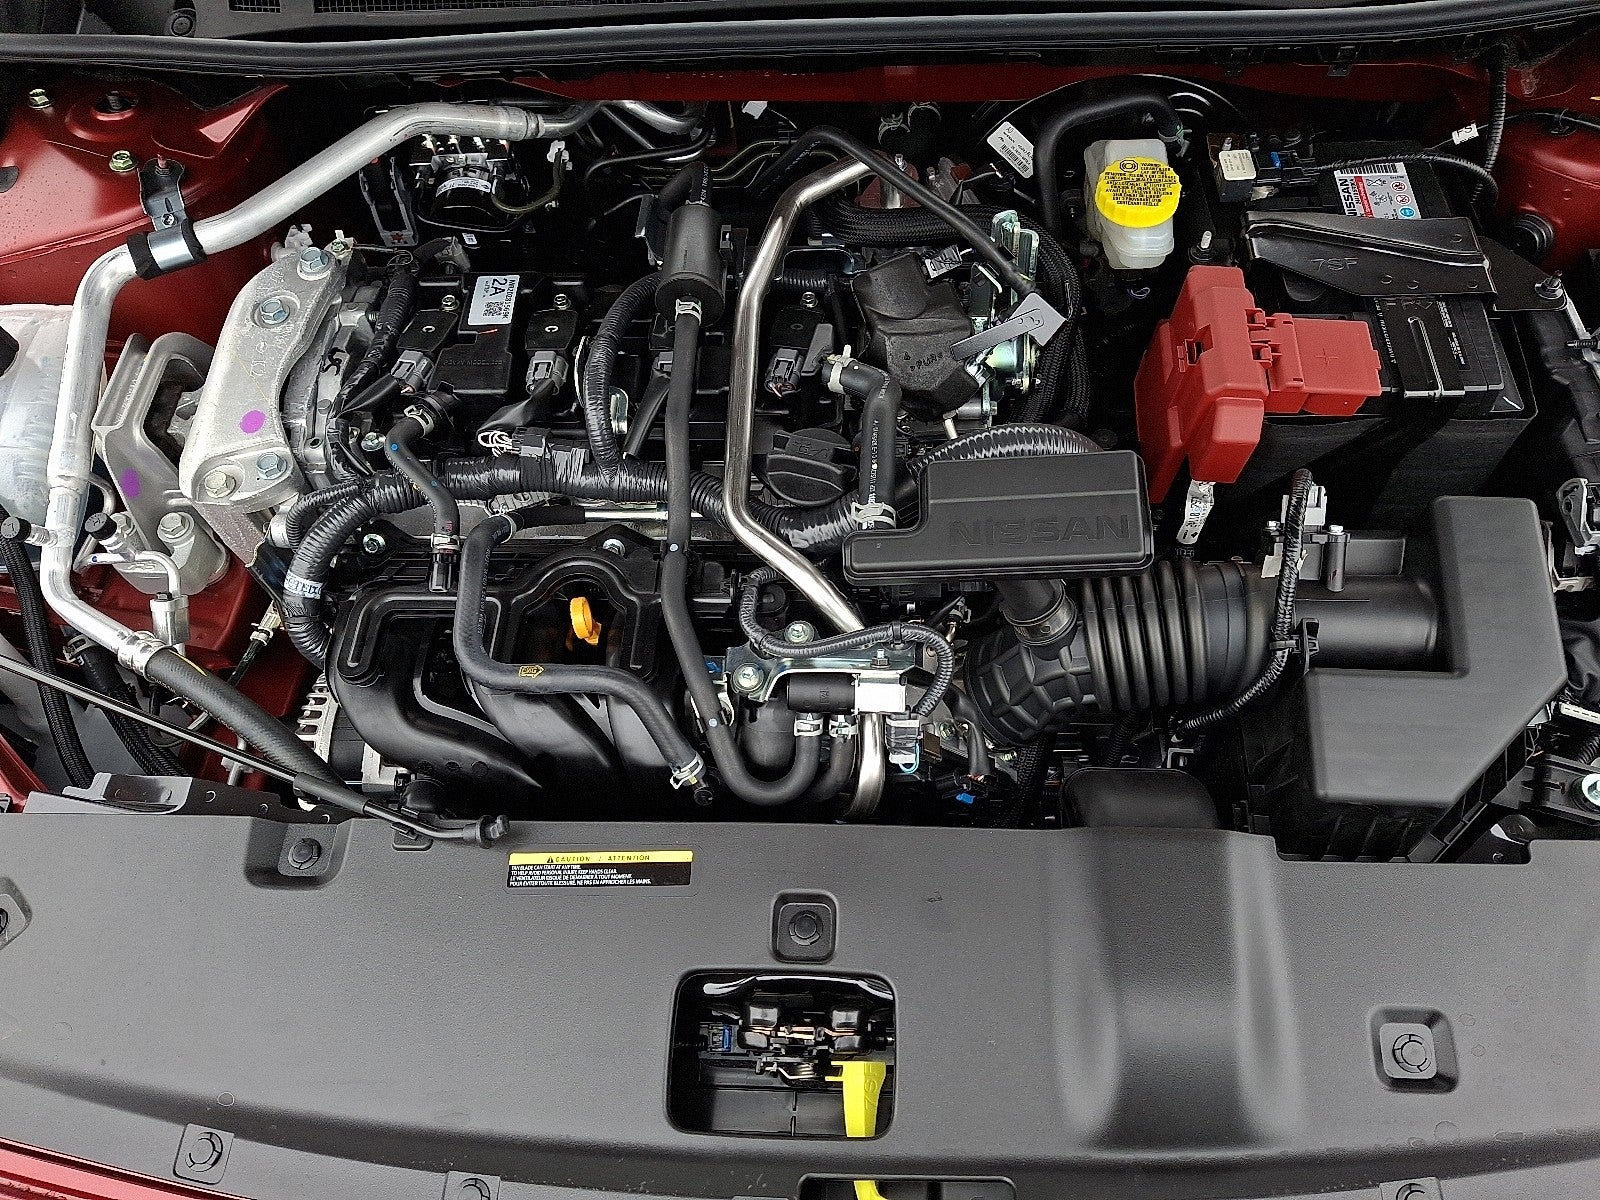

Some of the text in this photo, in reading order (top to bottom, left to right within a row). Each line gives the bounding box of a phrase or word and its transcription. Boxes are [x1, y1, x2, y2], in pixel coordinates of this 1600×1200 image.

[1310, 257, 1358, 272] 7SF
[489, 278, 508, 297] 2A
[950, 514, 1131, 547] NISSAN
[555, 855, 591, 863] CAUTION
[607, 854, 651, 862] ATTENTION
